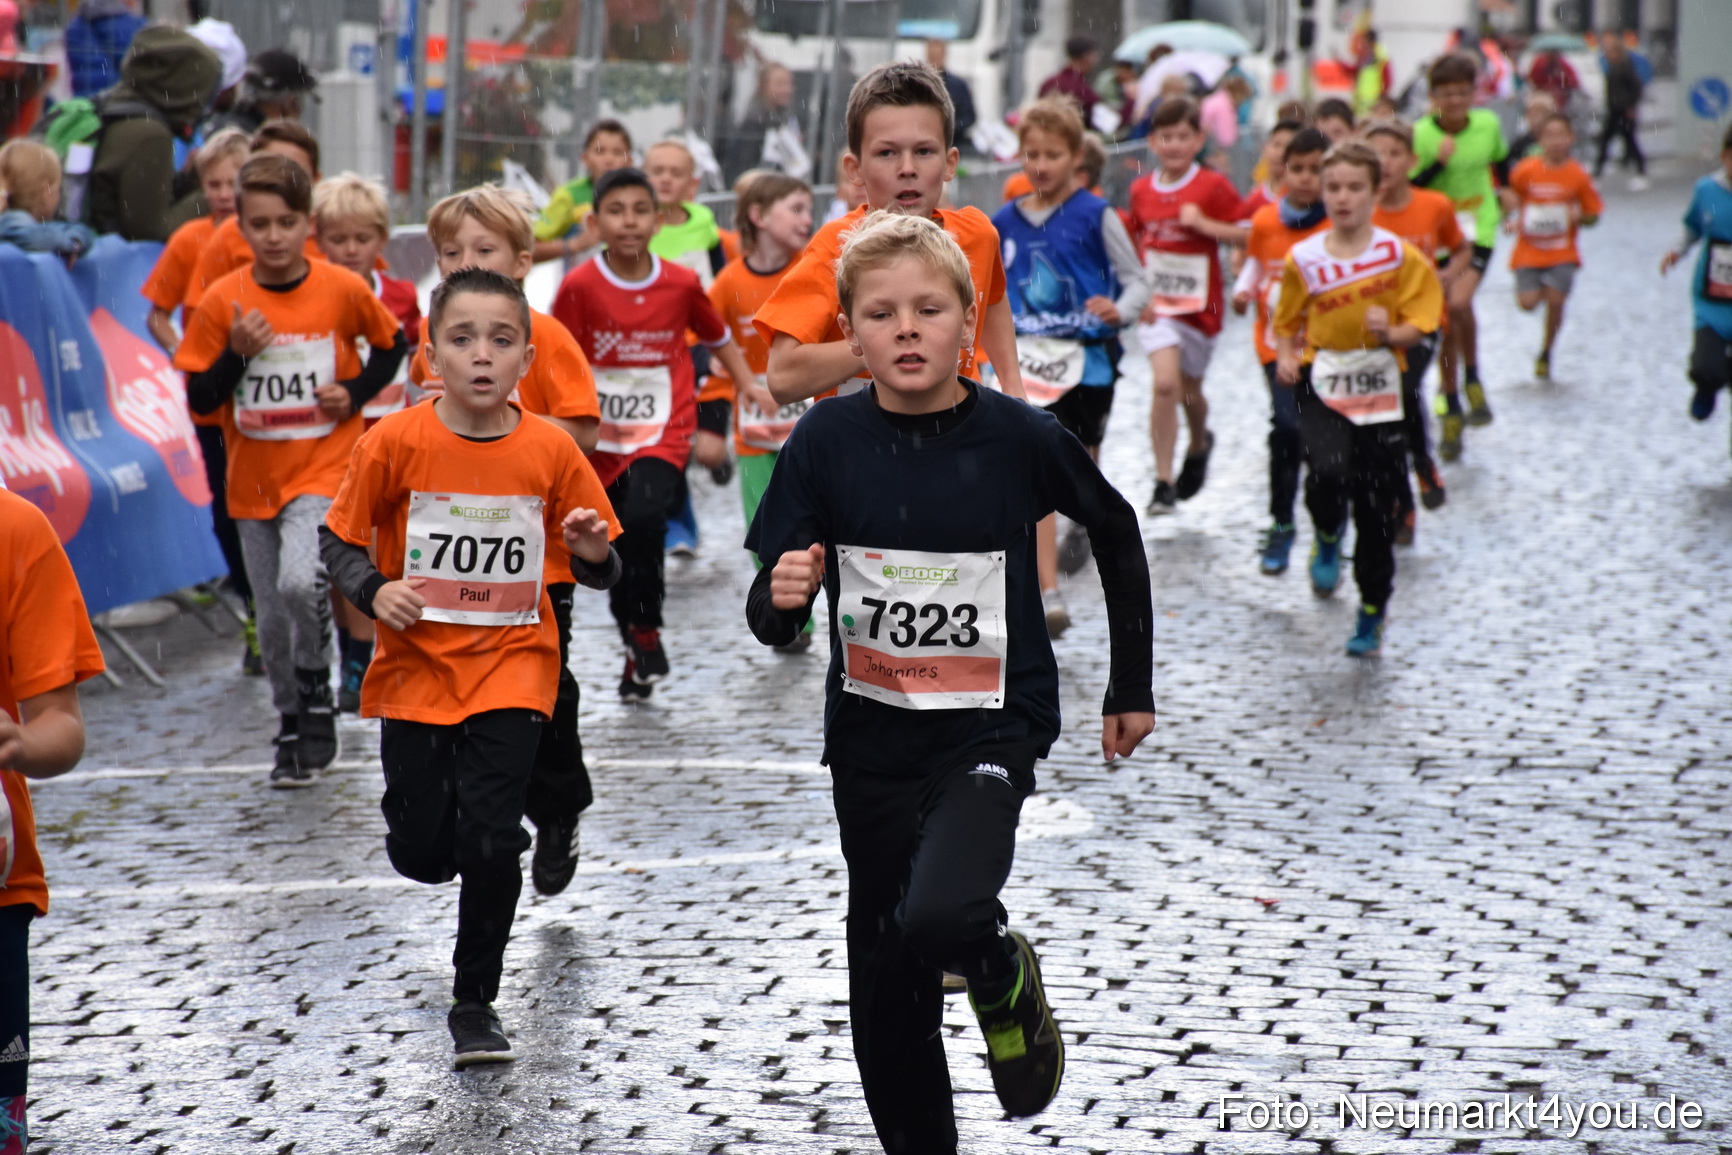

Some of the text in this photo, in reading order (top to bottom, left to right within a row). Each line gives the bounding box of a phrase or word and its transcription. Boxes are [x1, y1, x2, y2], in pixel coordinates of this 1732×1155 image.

[247, 371, 320, 404] 7041
[1326, 371, 1387, 395] 7196
[598, 392, 656, 420] 7023
[464, 506, 511, 520] BOCK
[428, 532, 526, 575] 7076
[409, 562, 420, 571] B6
[899, 566, 958, 582] BOCK
[460, 587, 491, 602] Paul
[861, 596, 980, 648] 7323
[864, 654, 938, 679] Johannes
[976, 763, 1009, 778] JAKO
[0, 1050, 29, 1062] adidas
